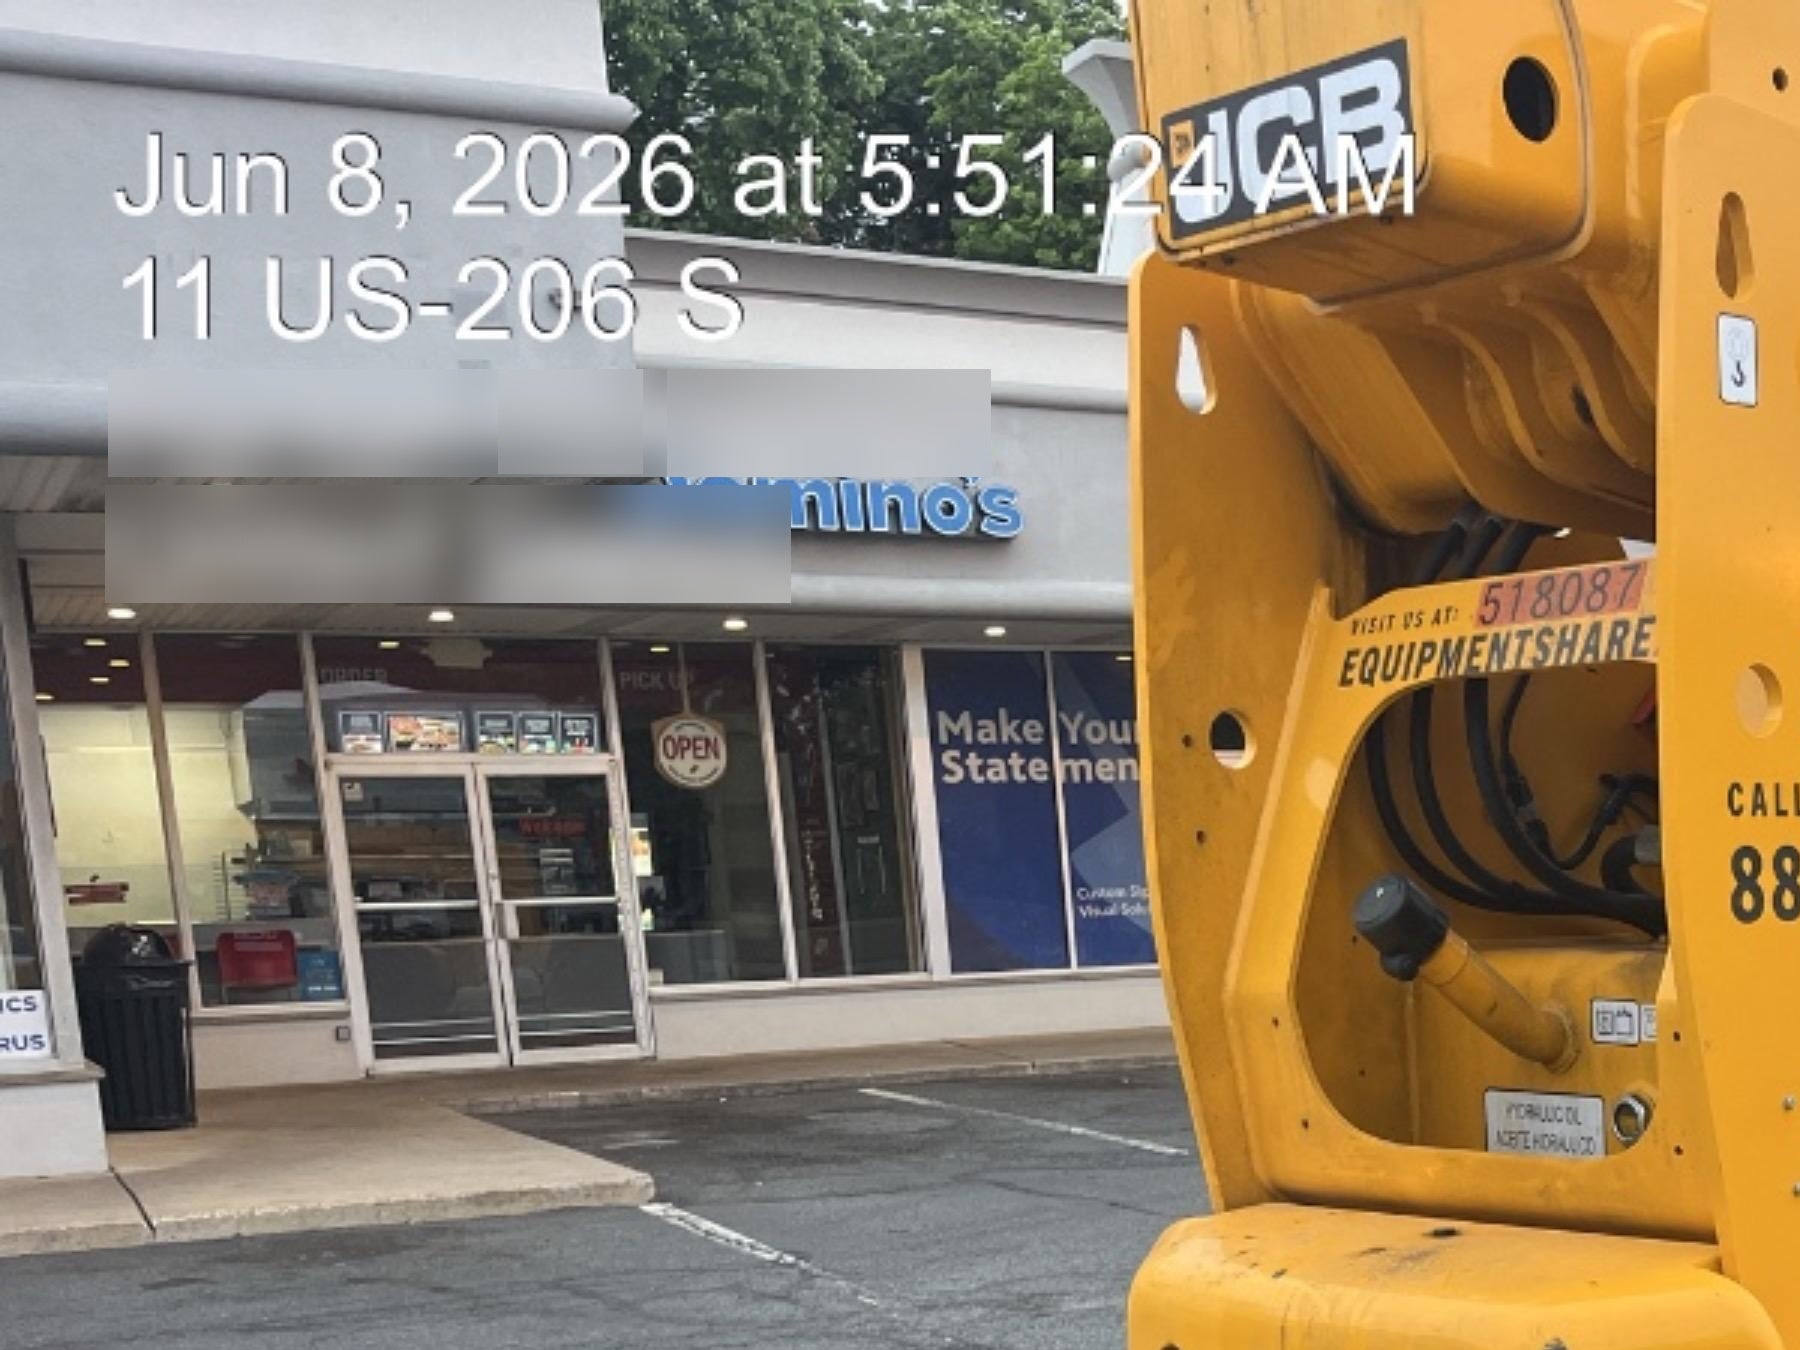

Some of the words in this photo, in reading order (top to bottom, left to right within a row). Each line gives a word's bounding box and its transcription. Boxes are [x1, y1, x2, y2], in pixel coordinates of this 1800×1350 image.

[1175, 58, 1405, 223] JCB
[1479, 563, 1640, 625] 518087
[1351, 613, 1396, 635] VISIT
[1402, 609, 1424, 630] US
[937, 708, 1044, 746] Make
[662, 735, 720, 760] OPEN
